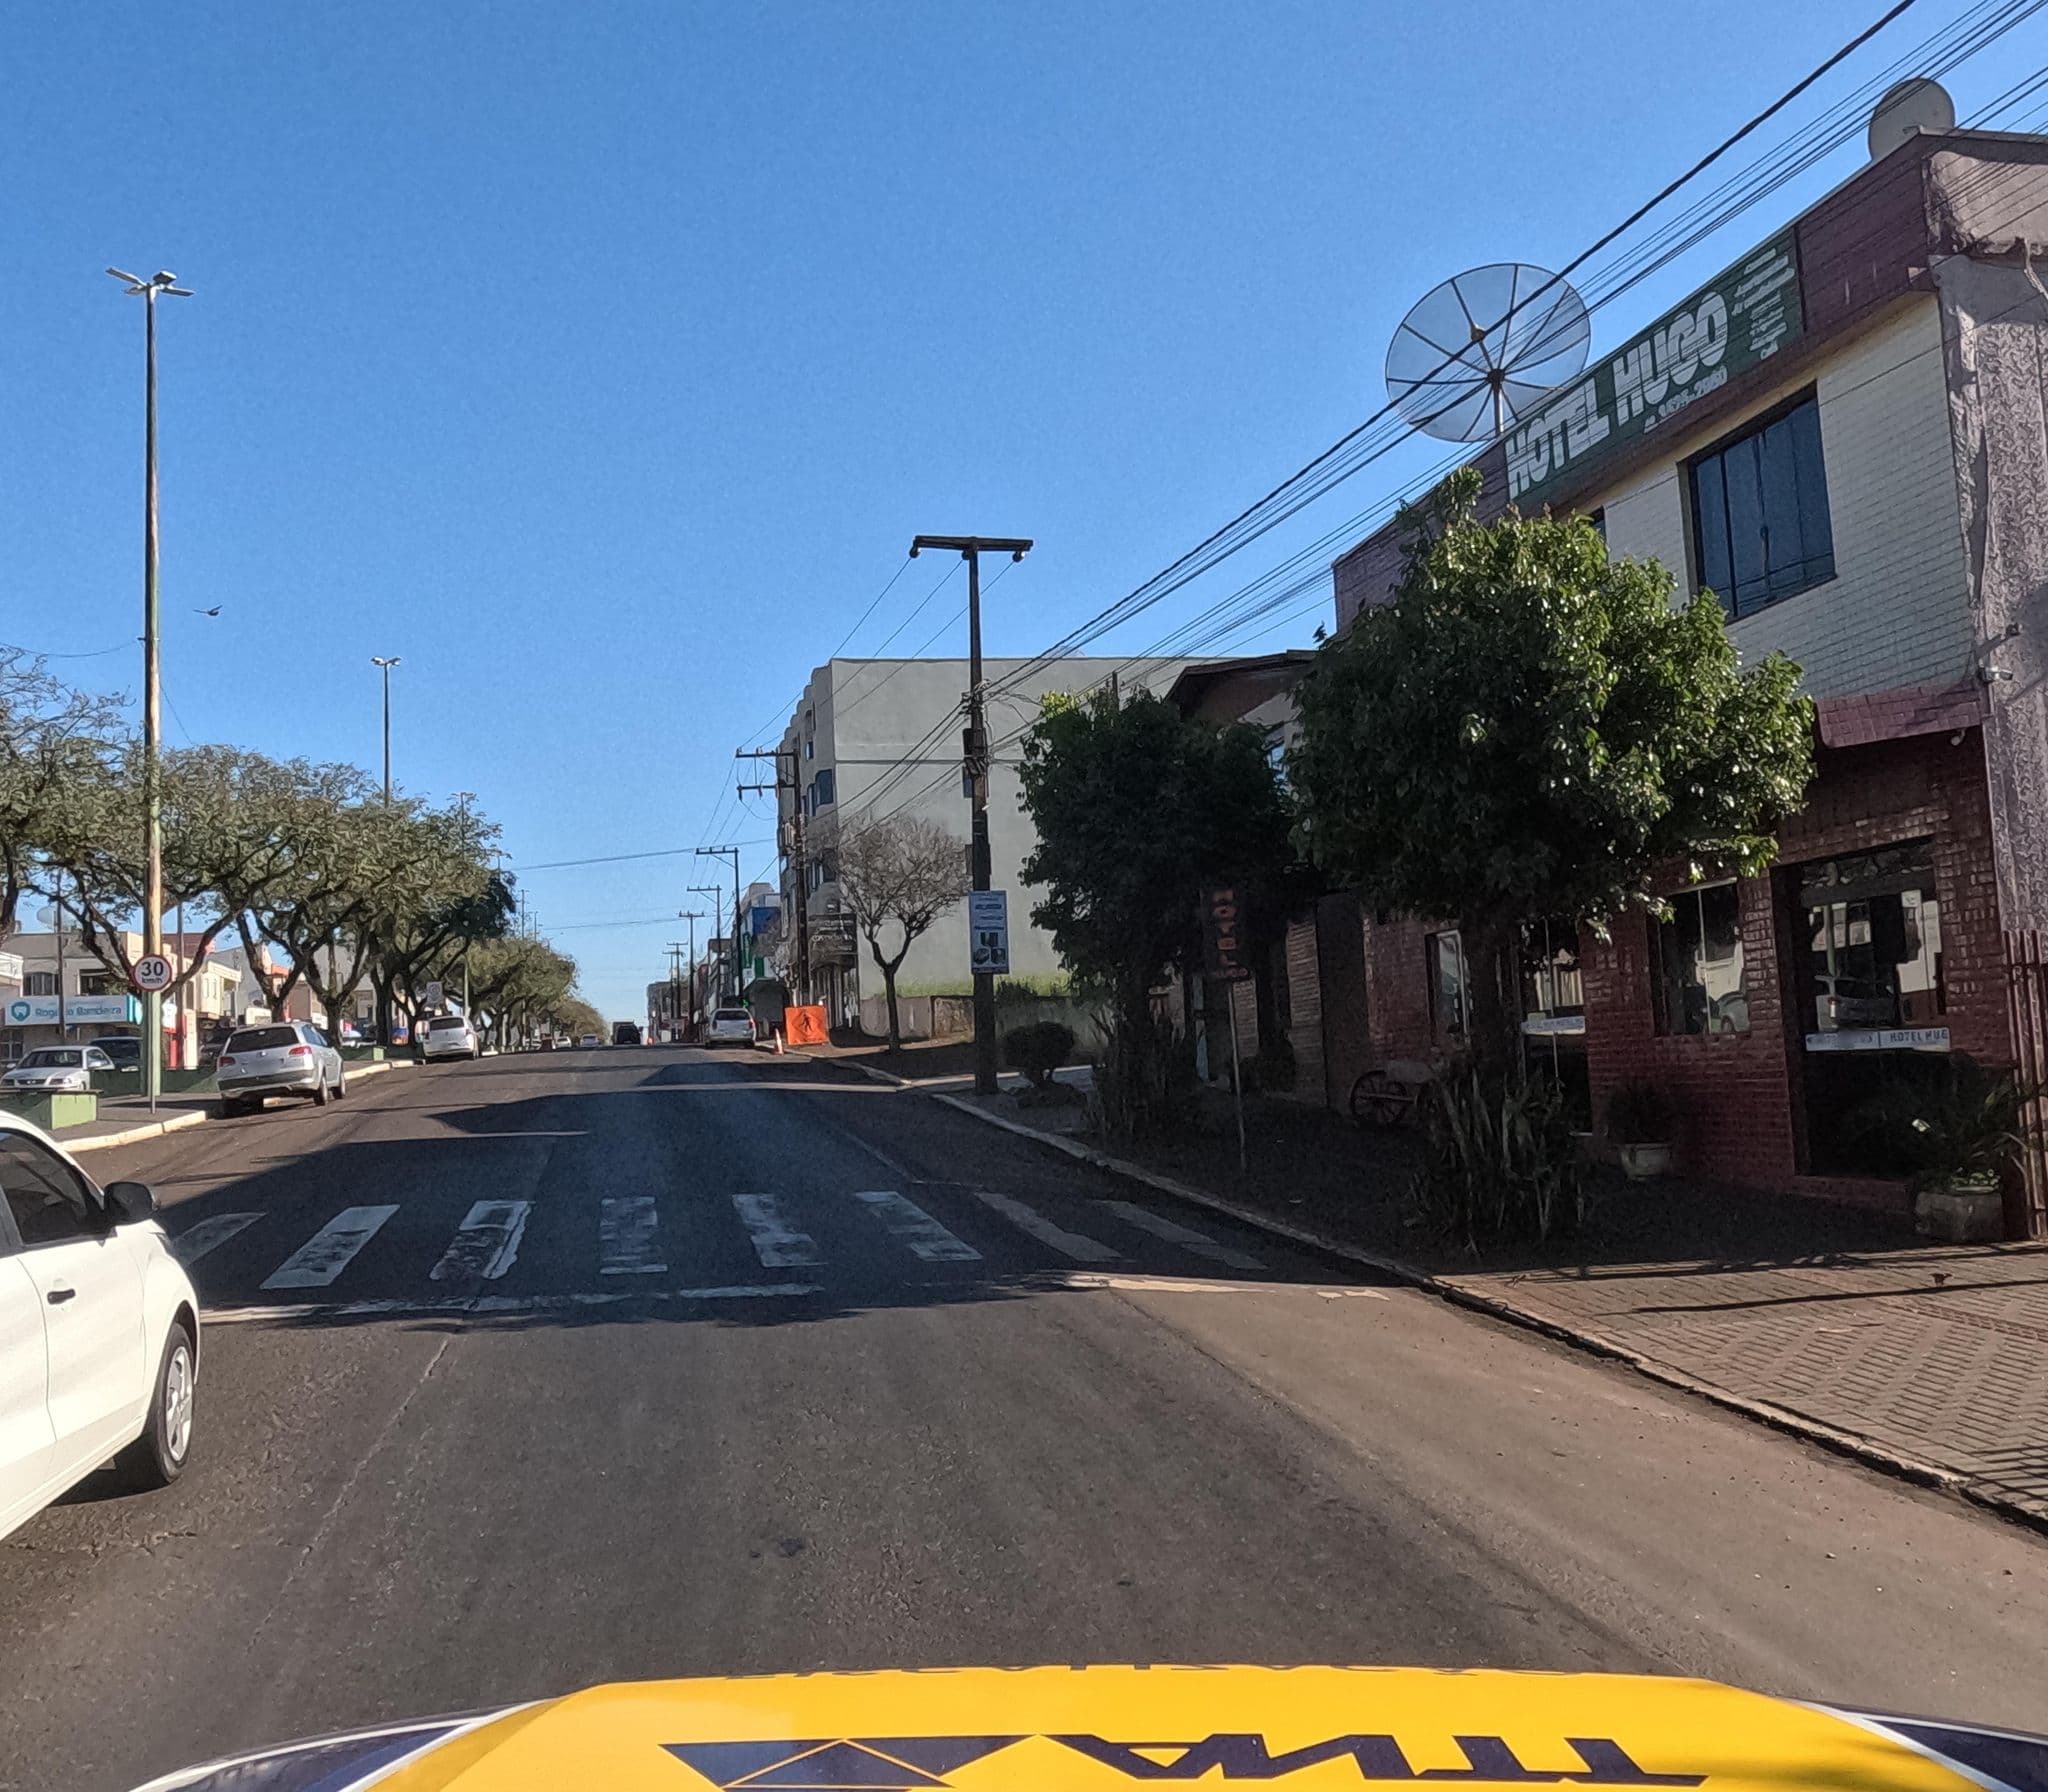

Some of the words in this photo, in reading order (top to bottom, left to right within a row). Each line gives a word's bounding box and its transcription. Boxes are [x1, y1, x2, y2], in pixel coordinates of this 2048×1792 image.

[1505, 377, 1611, 500] HOTEL
[1613, 291, 1729, 427] HUGO
[141, 961, 164, 976] 30
[1890, 1031, 1922, 1043] HOTEL
